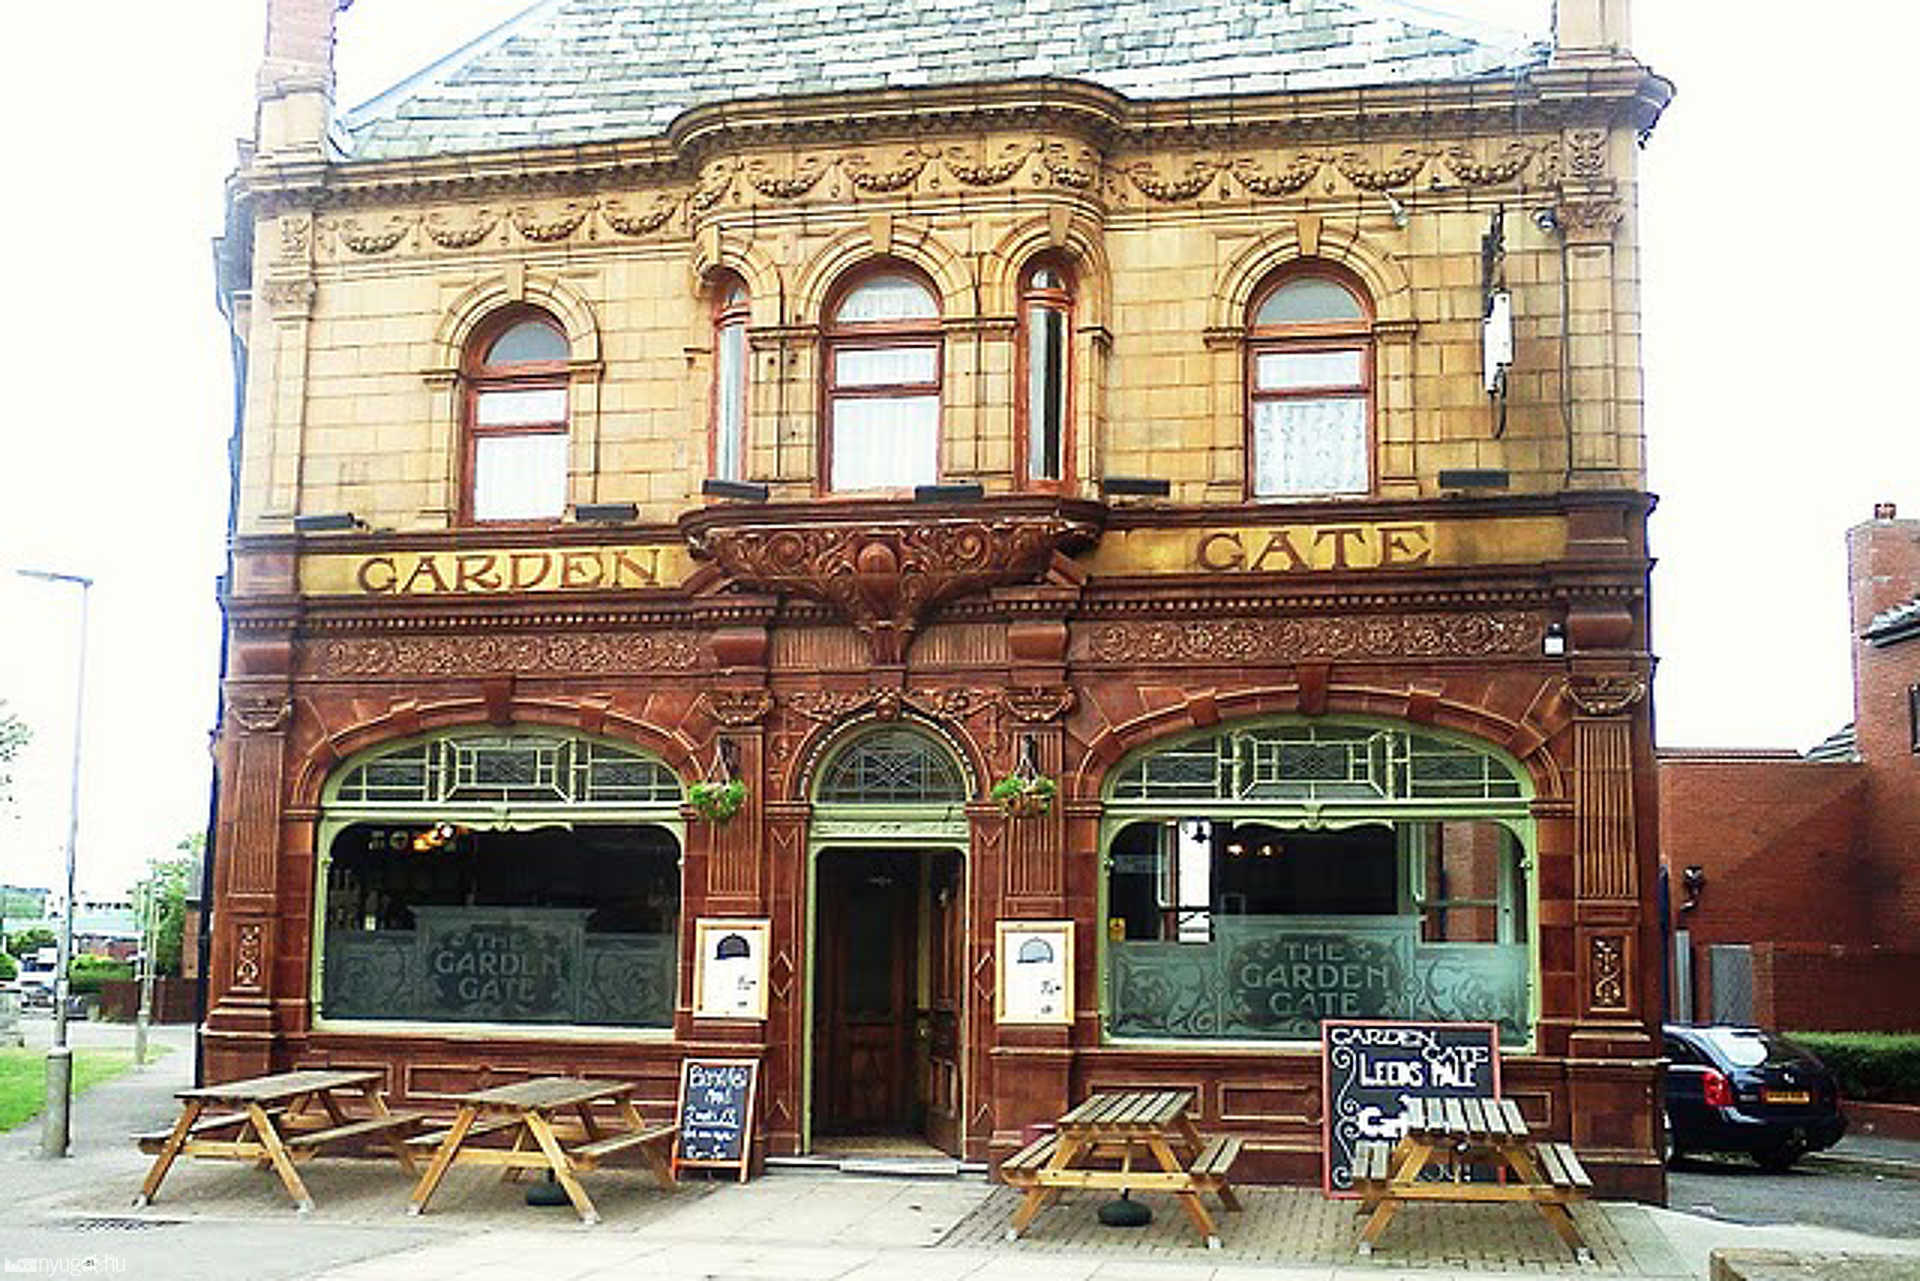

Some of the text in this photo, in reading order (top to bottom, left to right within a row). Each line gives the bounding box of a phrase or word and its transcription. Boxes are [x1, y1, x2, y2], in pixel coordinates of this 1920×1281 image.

[1197, 527, 1432, 573] GATE
[357, 549, 662, 594] GARDEN
[434, 951, 562, 977] GARDEN
[1285, 943, 1345, 962] THE
[458, 977, 537, 1001] GATE
[1240, 962, 1391, 990] GARDEN
[1268, 991, 1361, 1017] GATE
[1358, 1053, 1425, 1087] LEEDS
